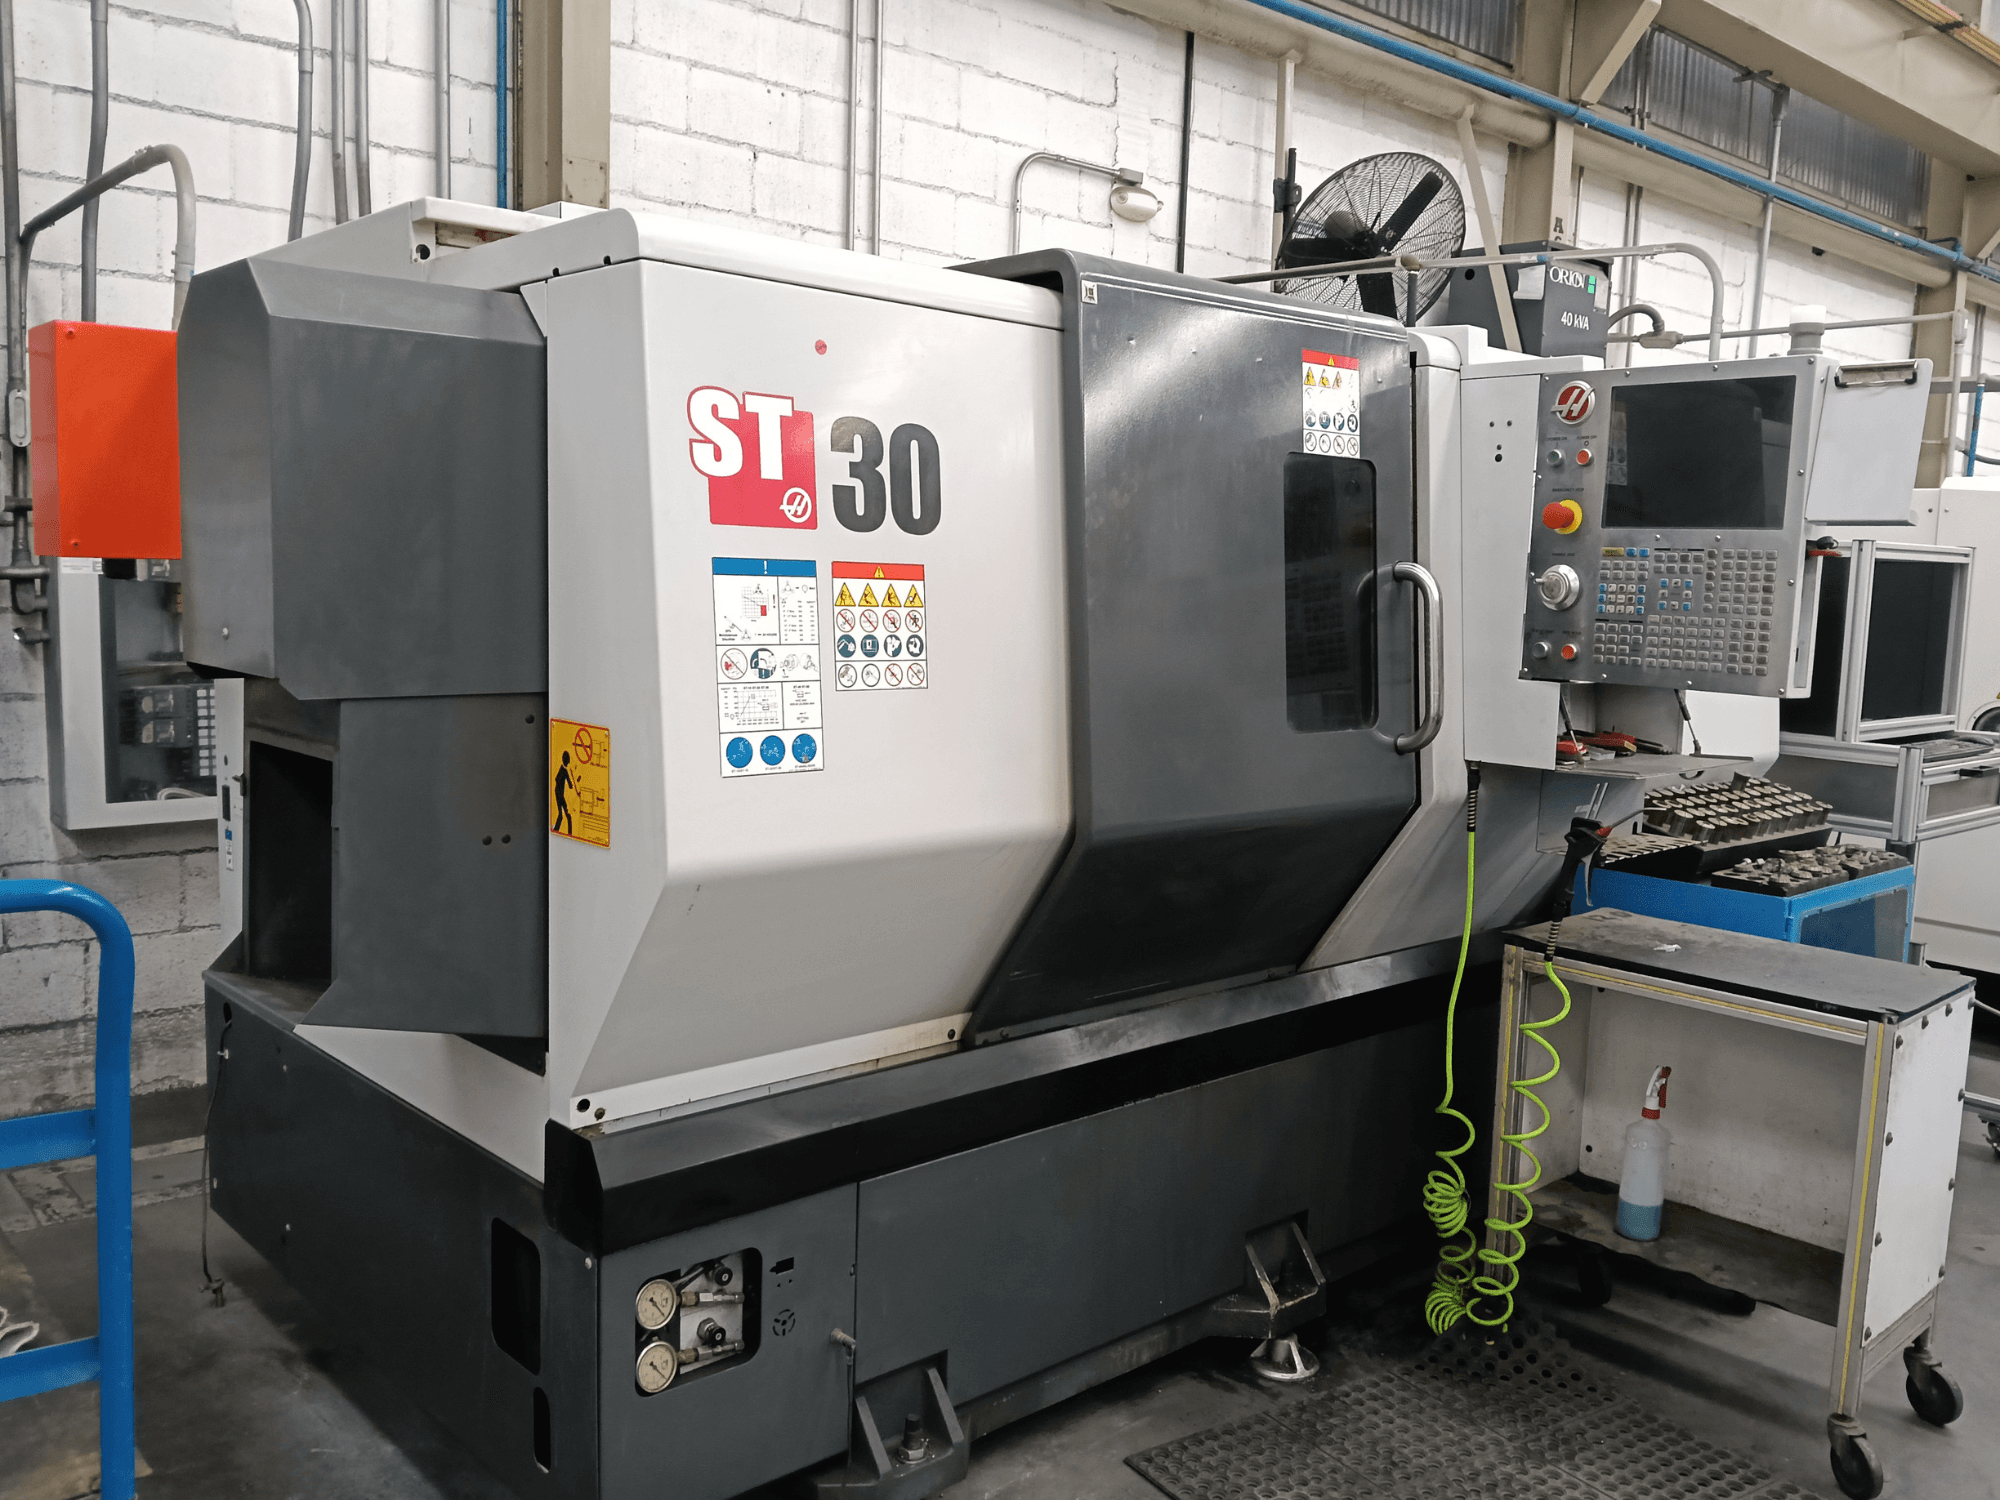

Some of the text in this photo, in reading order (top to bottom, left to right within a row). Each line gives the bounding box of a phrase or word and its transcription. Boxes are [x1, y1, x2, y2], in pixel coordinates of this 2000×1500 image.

[1549, 266, 1586, 289] ORION
[1561, 310, 1590, 331] 40 kVA
[686, 385, 942, 536] ST 30
